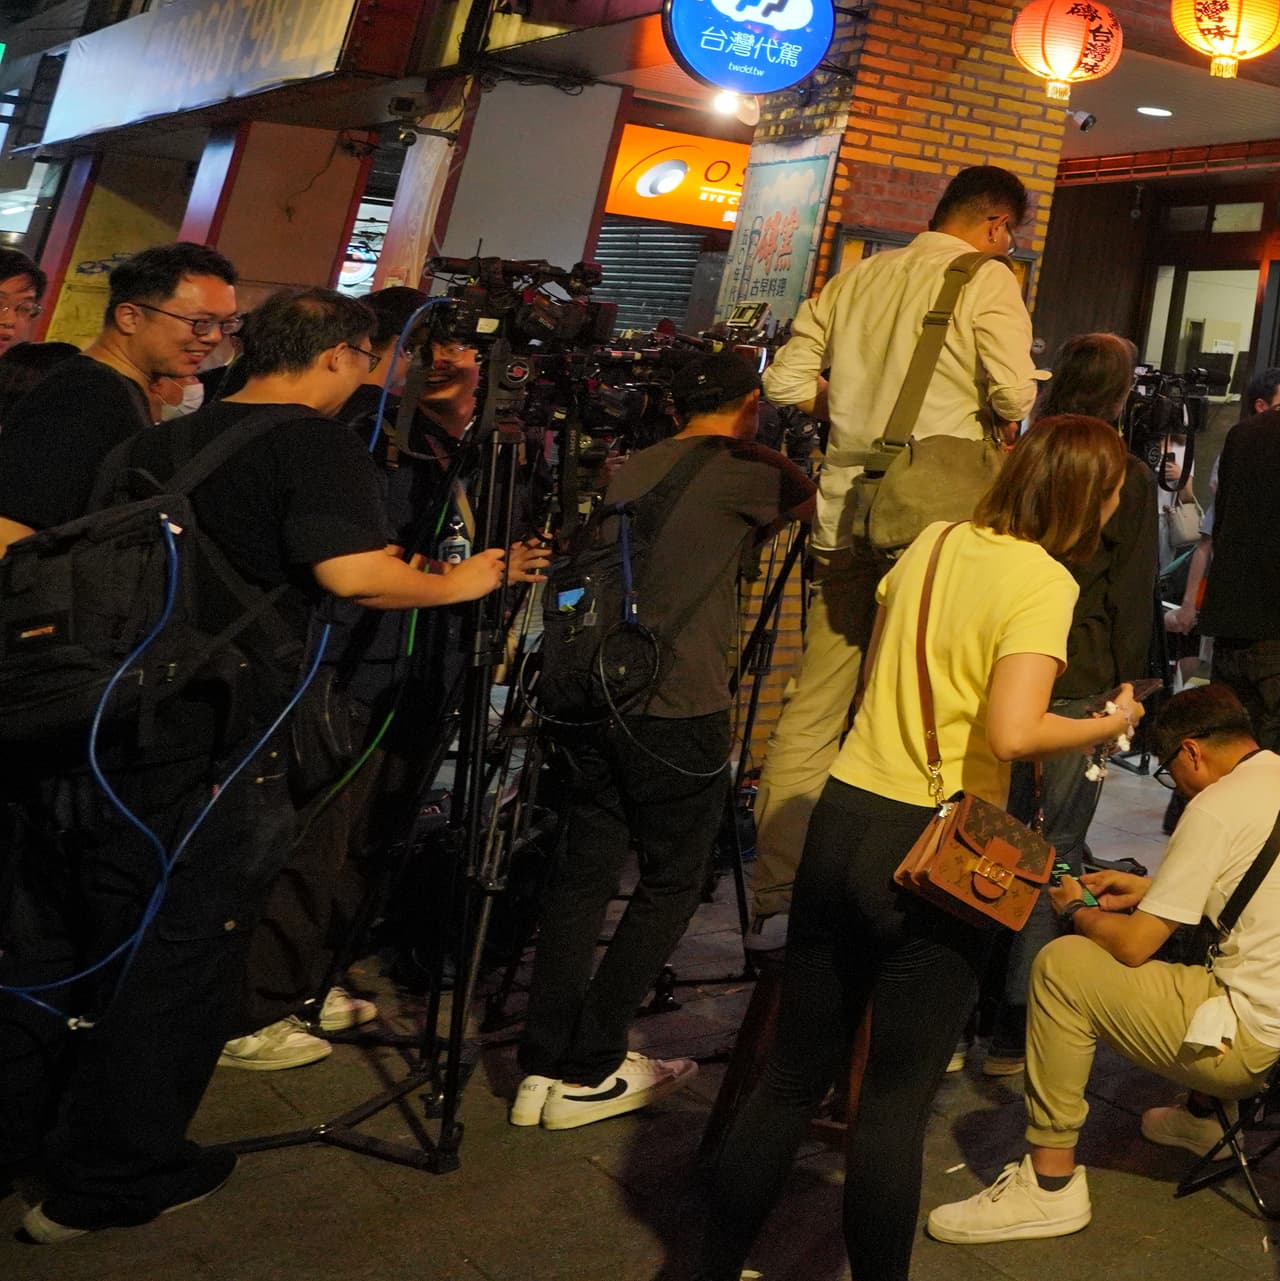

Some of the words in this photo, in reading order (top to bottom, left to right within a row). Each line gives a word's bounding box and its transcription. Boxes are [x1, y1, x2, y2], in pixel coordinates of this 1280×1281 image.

[699, 25, 803, 68] 台灣代駕
[699, 191, 725, 203] EYE
